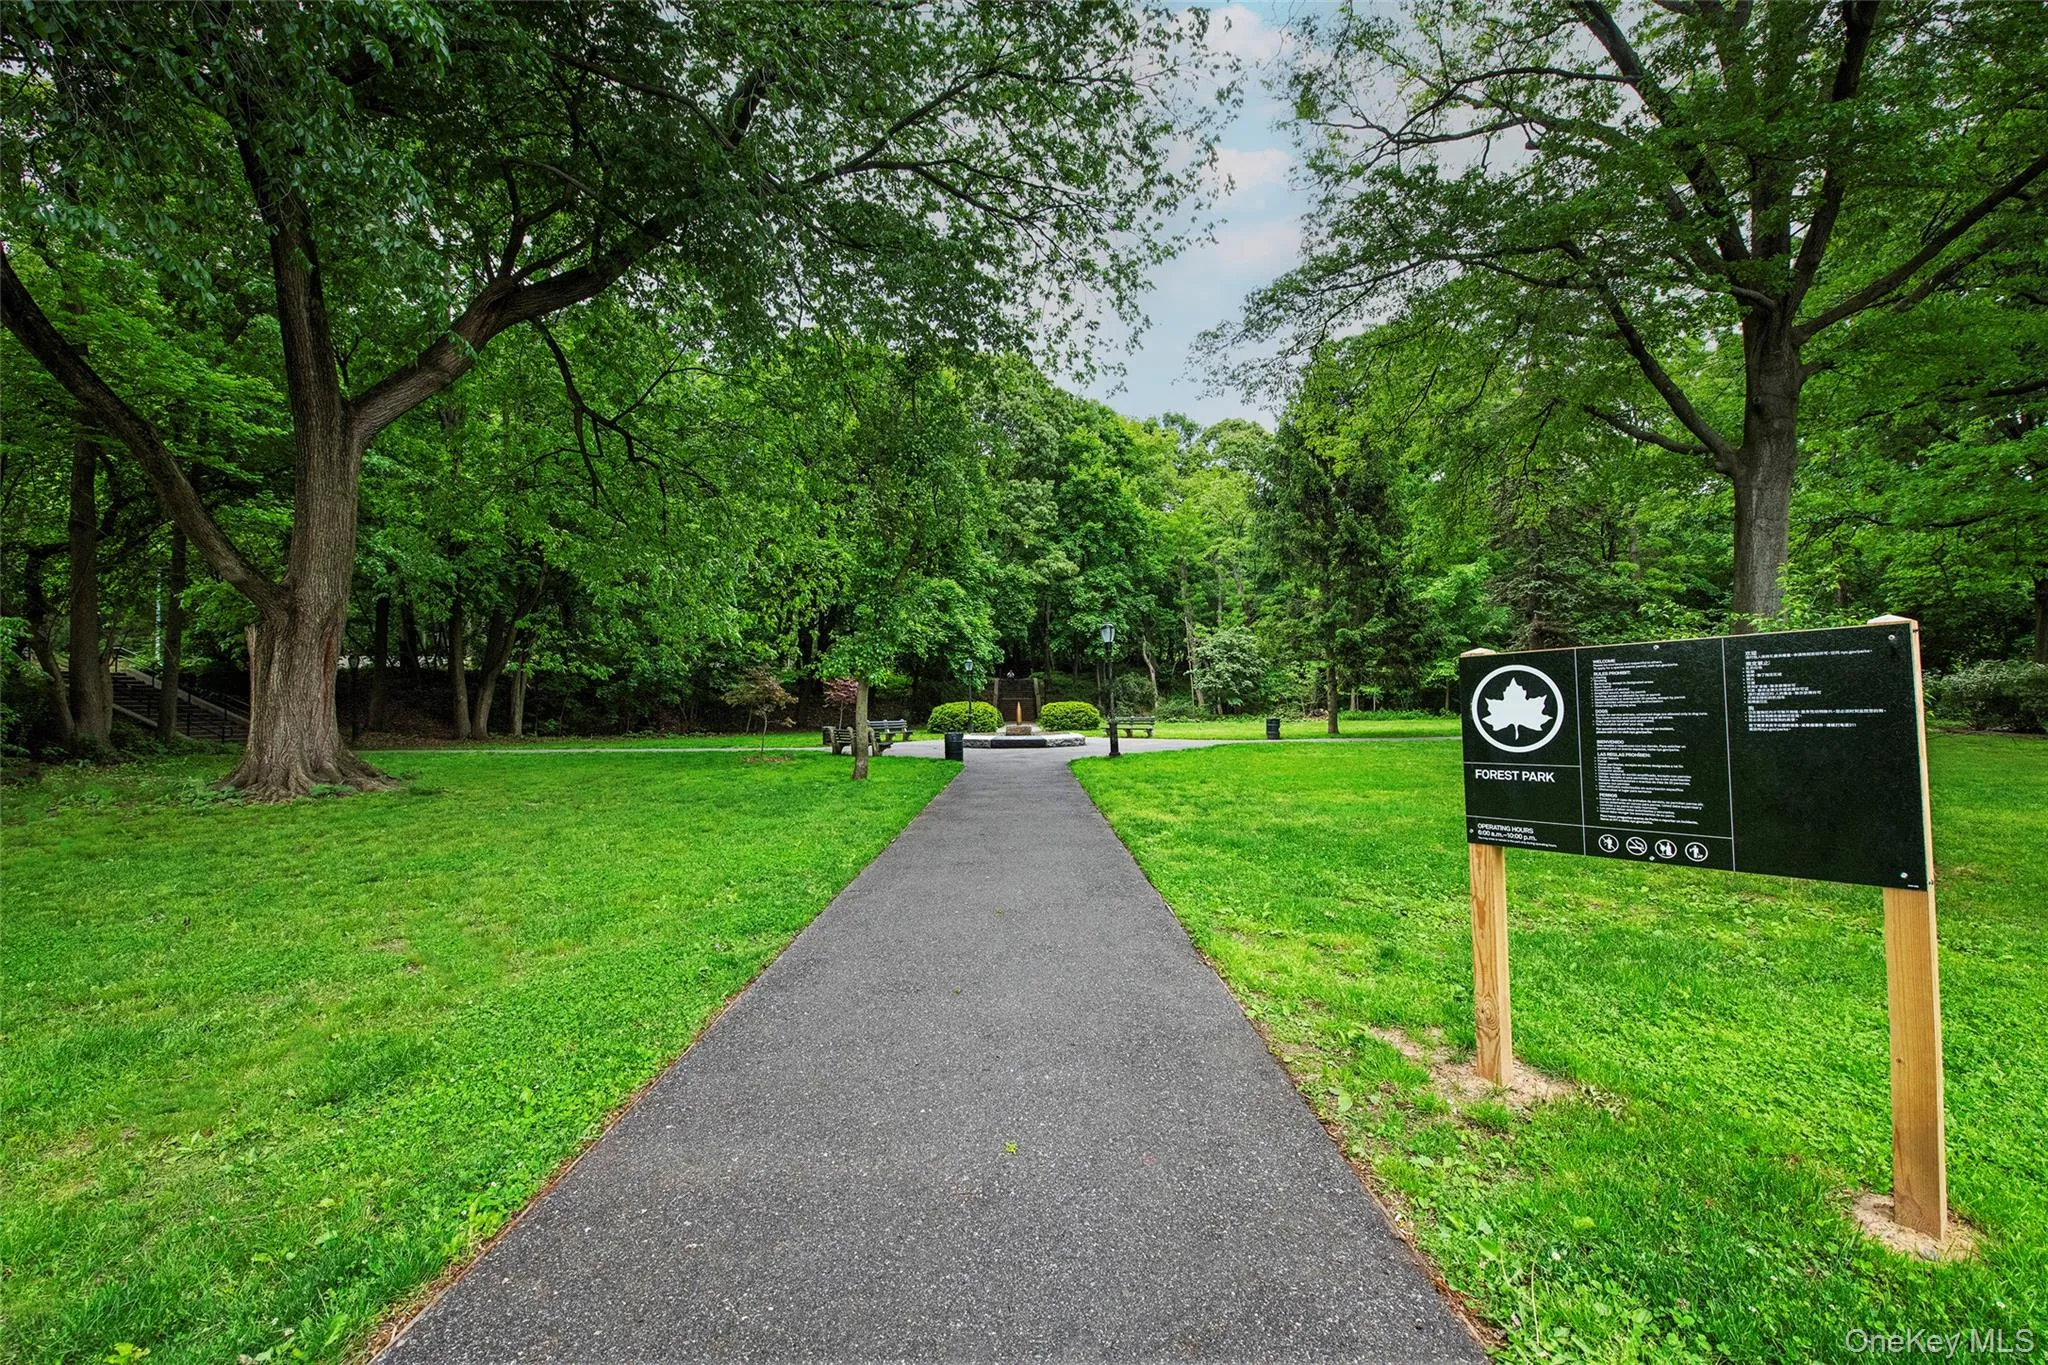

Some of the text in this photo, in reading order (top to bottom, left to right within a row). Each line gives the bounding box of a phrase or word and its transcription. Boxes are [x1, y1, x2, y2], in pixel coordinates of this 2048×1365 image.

[1475, 769, 1555, 783] FOREST PARK
[1478, 823, 1534, 834] OPERATING HOURS
